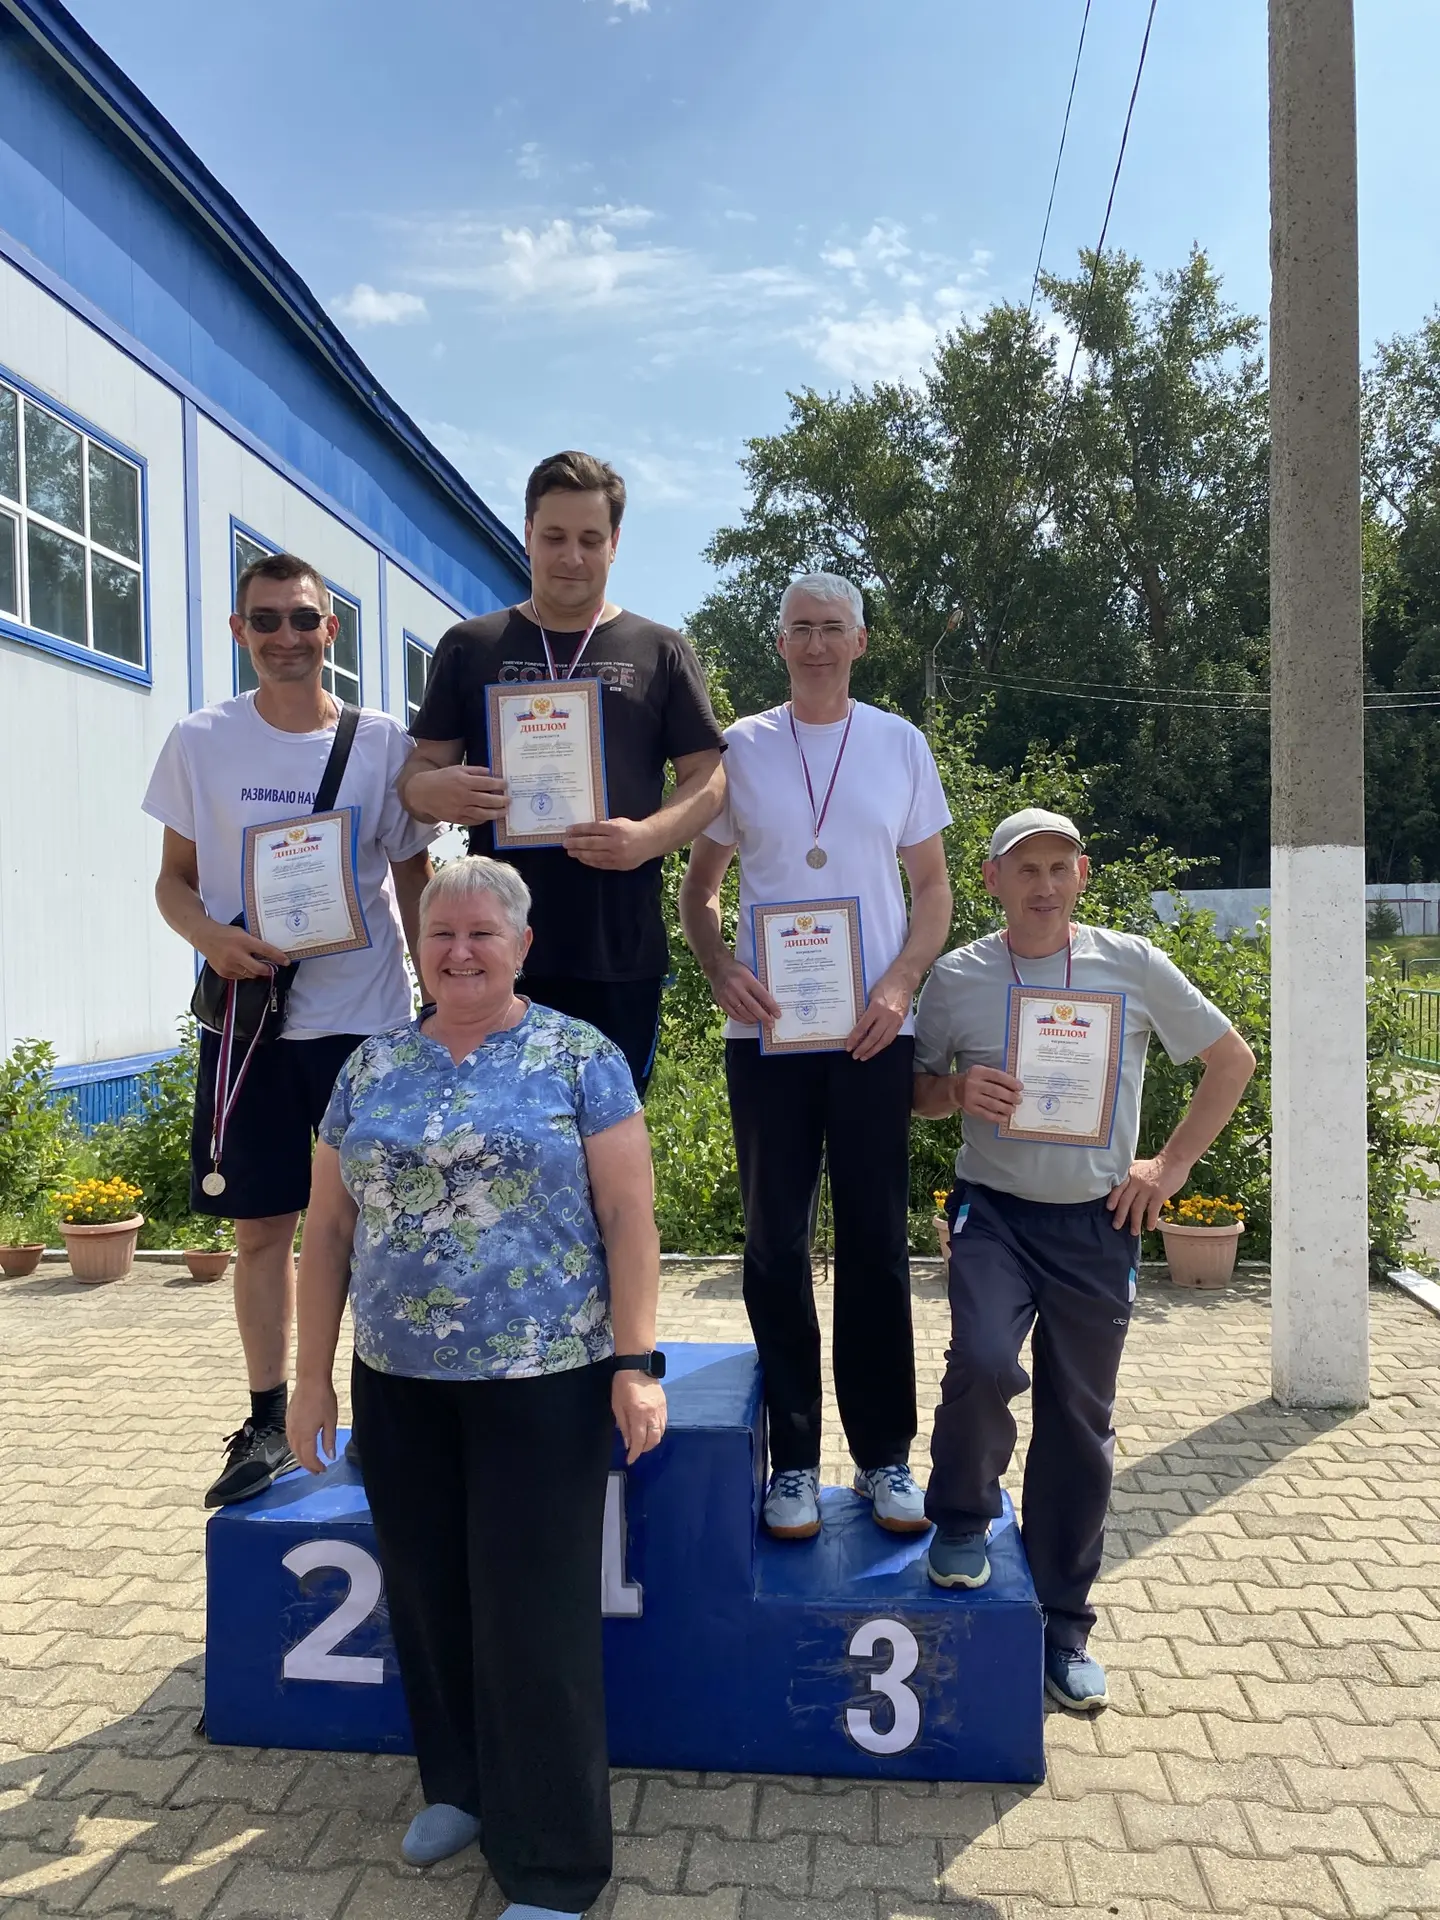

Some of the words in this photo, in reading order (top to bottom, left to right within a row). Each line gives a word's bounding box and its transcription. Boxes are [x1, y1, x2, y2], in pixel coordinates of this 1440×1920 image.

[520, 722, 566, 734] ДИПЛОМ
[241, 788, 296, 804] РАЗВИВАЮ
[297, 791, 316, 805] НАУ
[273, 844, 319, 859] ДИПЛОМ
[784, 937, 828, 948] ДИПЛОМ
[1039, 1027, 1087, 1039] ДИПЛОМ
[282, 1540, 384, 1684] 2
[847, 1618, 920, 1754] 3
